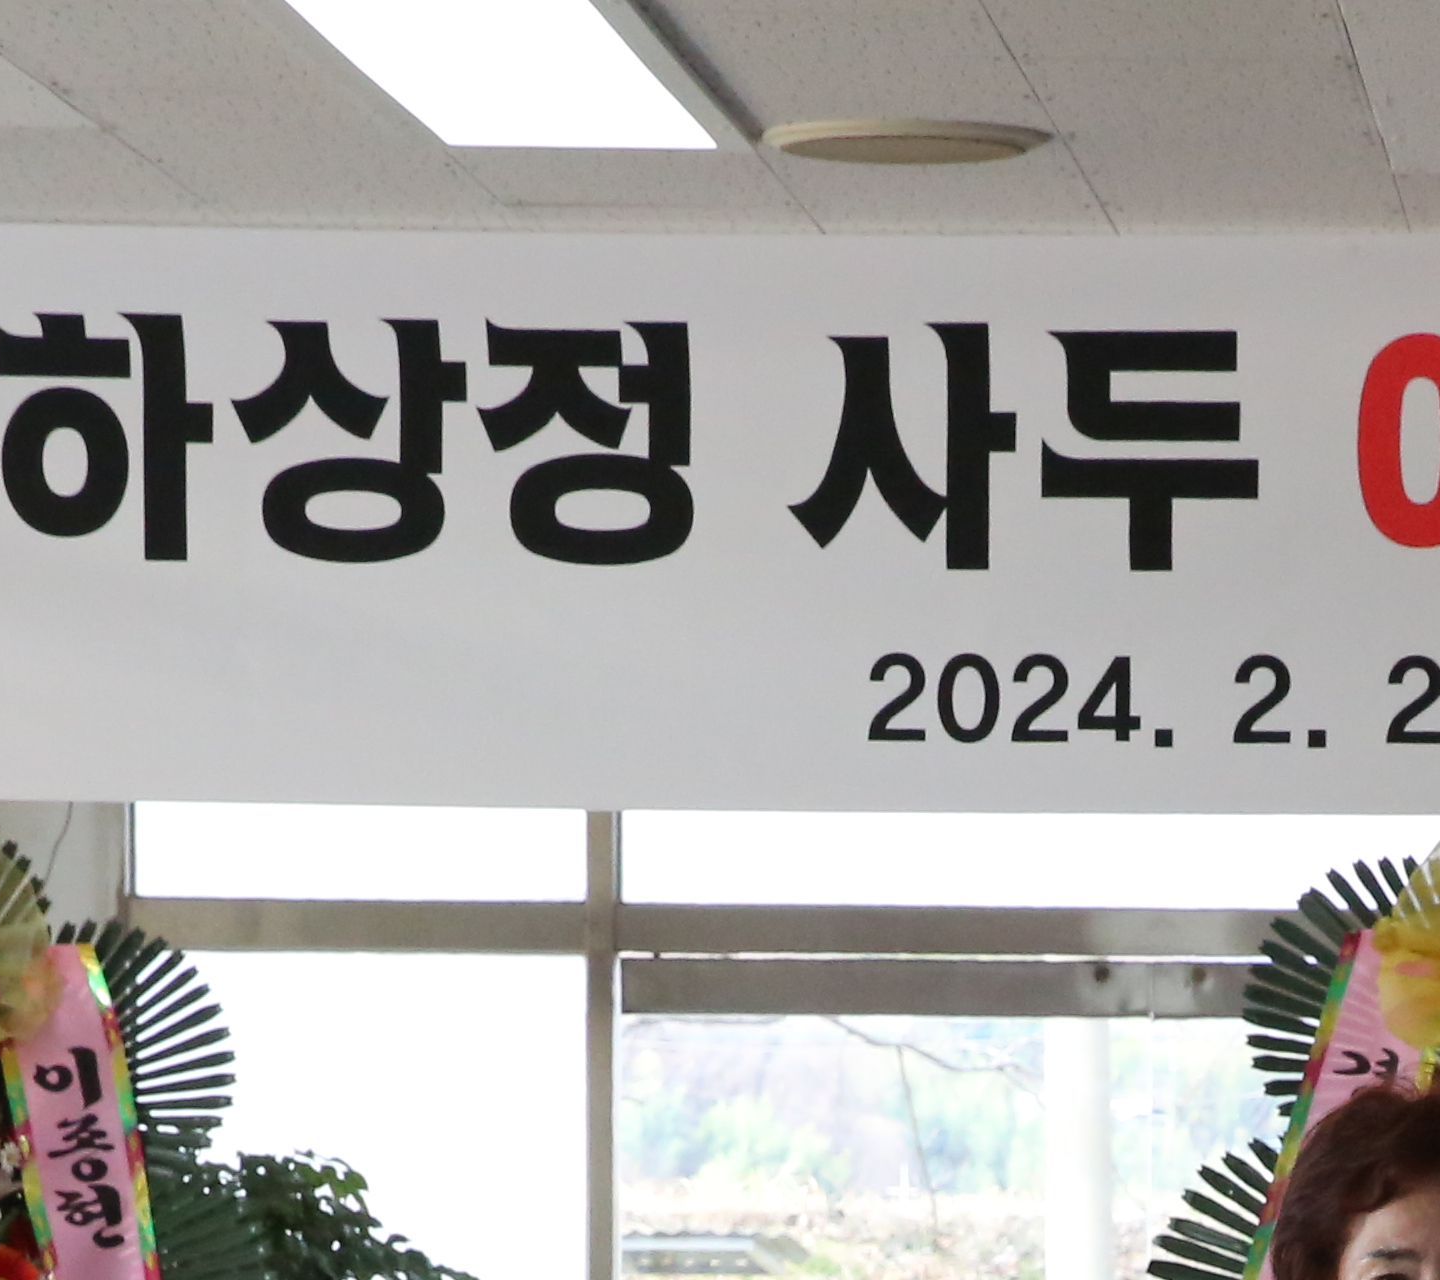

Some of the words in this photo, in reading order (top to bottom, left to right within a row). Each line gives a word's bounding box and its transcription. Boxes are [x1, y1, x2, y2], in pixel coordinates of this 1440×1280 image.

[787, 322, 1259, 572] 사두
[868, 652, 1173, 748] 2024.
[1233, 654, 1327, 748] 2.
[33, 1046, 125, 1249] 이종현
